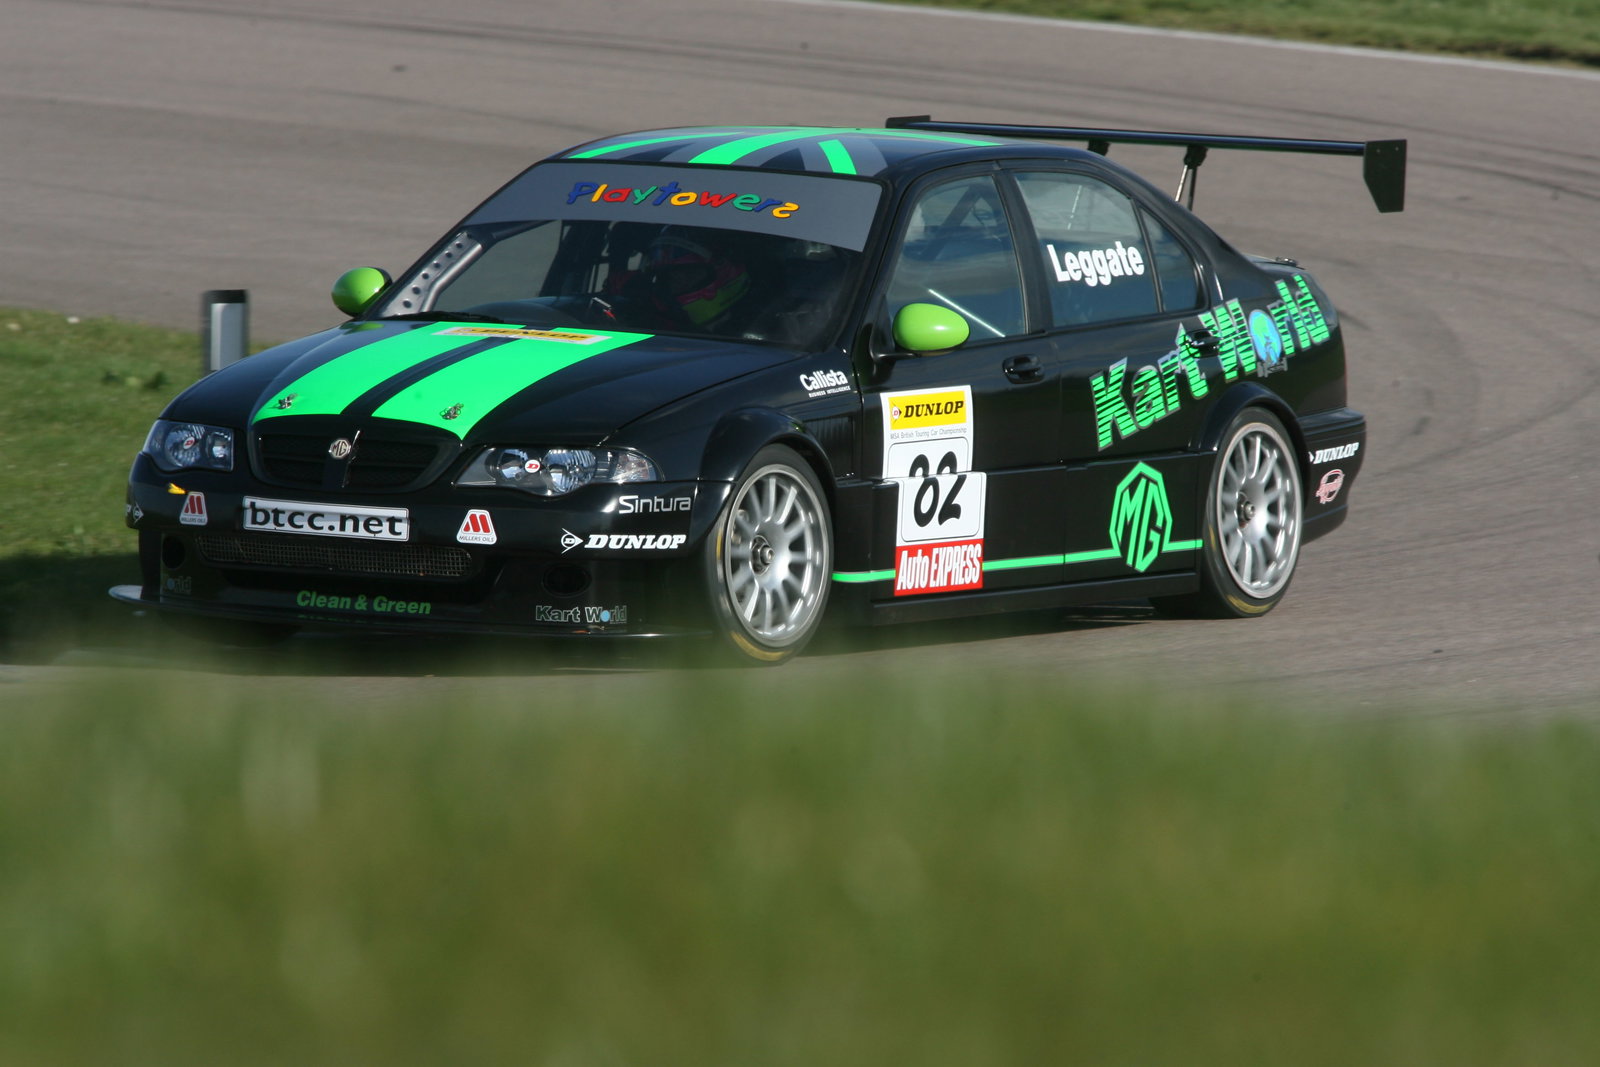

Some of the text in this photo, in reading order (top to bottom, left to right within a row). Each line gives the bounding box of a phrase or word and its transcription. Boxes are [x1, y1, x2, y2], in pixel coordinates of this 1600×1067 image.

[567, 180, 800, 219] Playtowers
[1047, 241, 1145, 287] Leggate
[1089, 273, 1331, 452] Kart World
[799, 369, 848, 391] Callista
[904, 401, 964, 418] DUNLOP
[1313, 442, 1360, 464] DUNLOP
[618, 495, 691, 514] Sintura
[250, 502, 403, 536] btcc.net
[584, 534, 686, 549] DUNLOP
[896, 543, 982, 591] Auto EXPRESS
[296, 590, 432, 614] Clean & Green
[535, 605, 628, 623] Kart World
